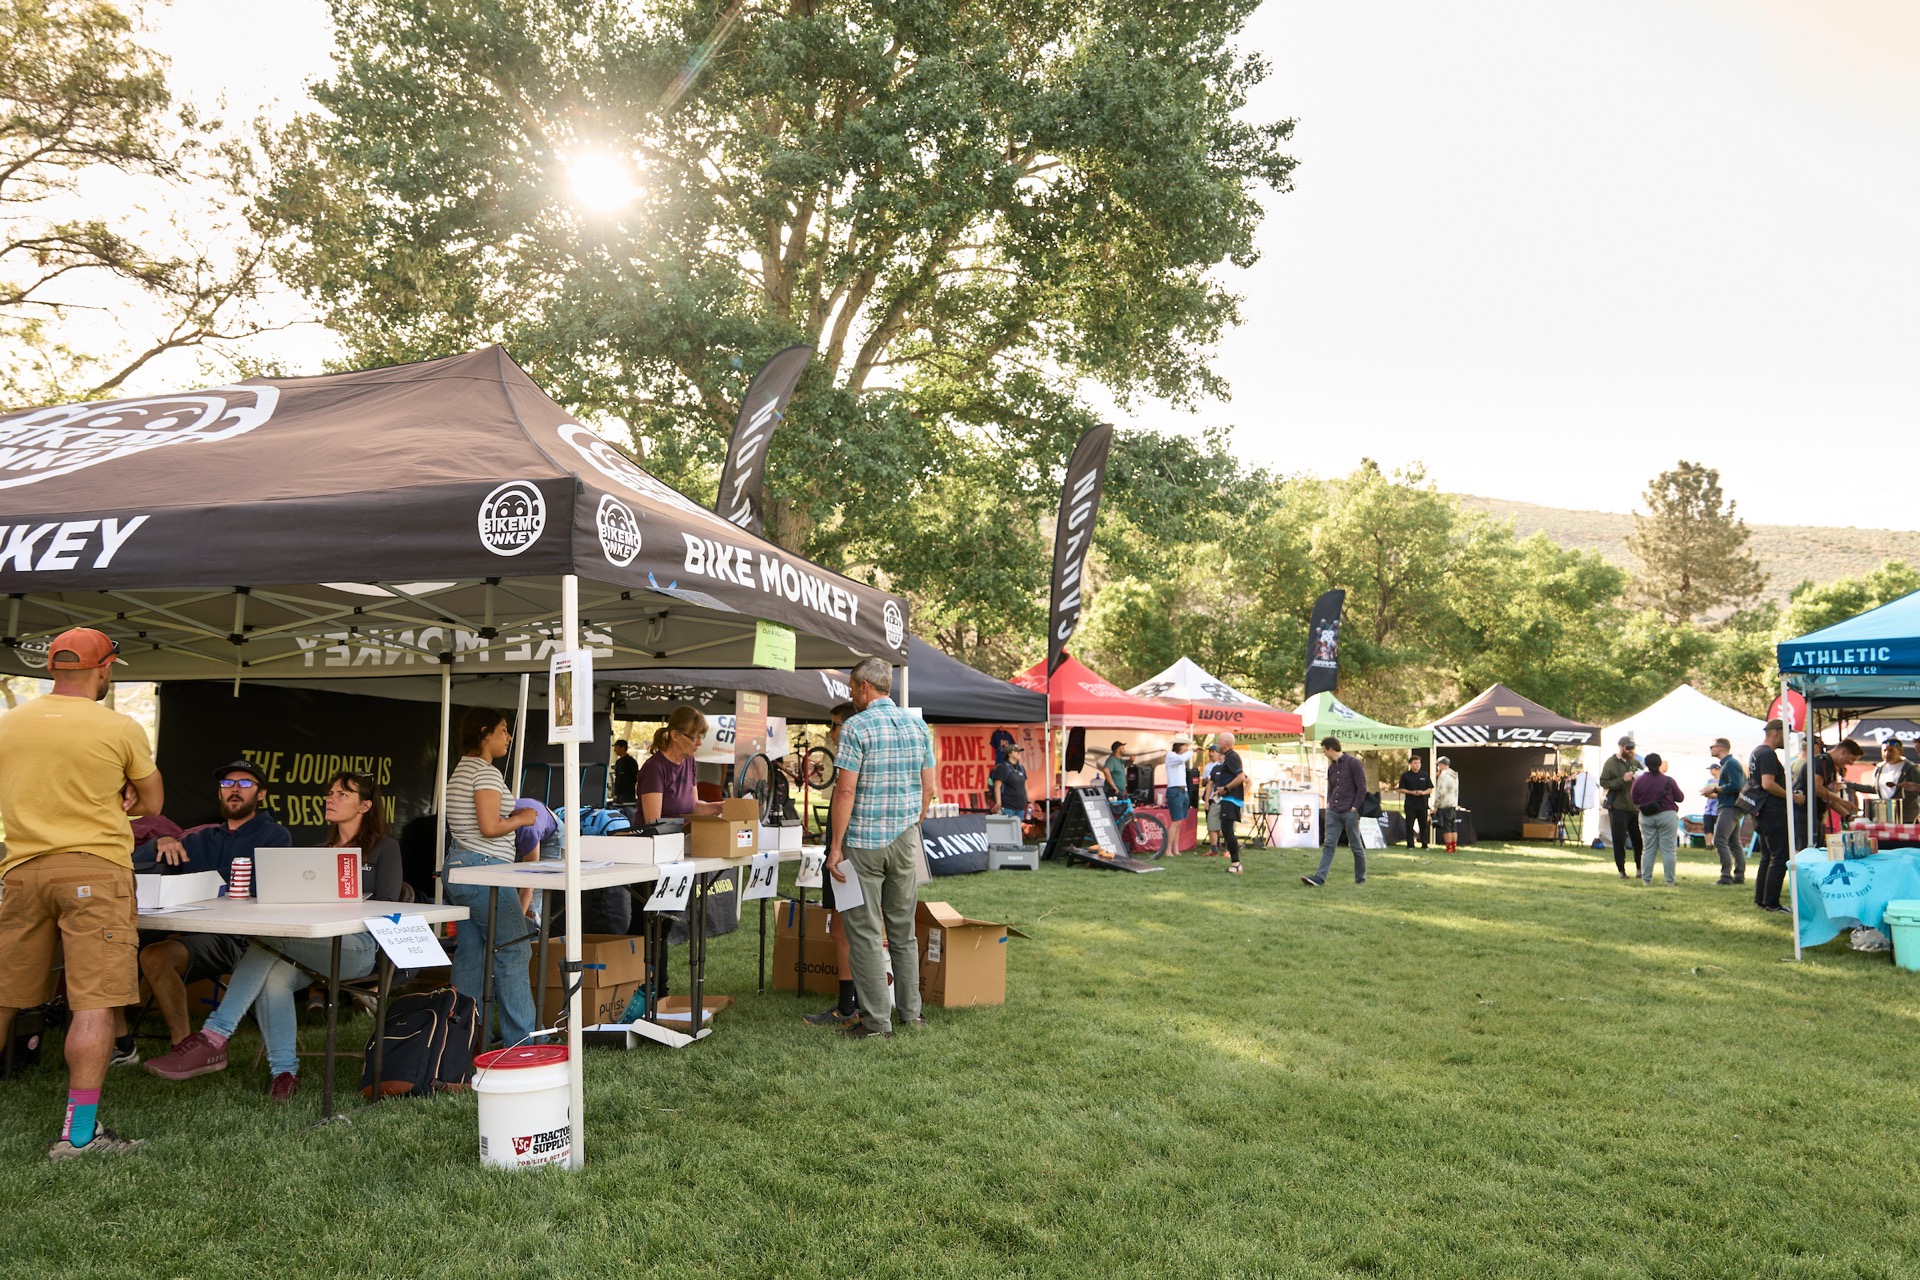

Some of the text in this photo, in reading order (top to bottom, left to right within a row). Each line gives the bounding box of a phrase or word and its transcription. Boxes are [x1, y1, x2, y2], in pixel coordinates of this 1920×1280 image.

[727, 396, 779, 528] NYON
[0, 515, 150, 571] KEY
[1057, 467, 1097, 641] CANYON
[682, 532, 858, 626] BIKE MONKEY
[1791, 647, 1890, 666] ATHLETIC
[1809, 666, 1859, 674] BREWING
[716, 729, 736, 744] CIT
[1330, 729, 1419, 742] RENEWAL by ANDERSEN
[1497, 727, 1592, 743] VOLER
[940, 736, 986, 761] HAVE
[242, 750, 392, 785] THE JOURNEY IS
[376, 925, 427, 936] REG CHANGES
[394, 936, 415, 945] SAME
[408, 946, 423, 954] REG
[794, 962, 838, 975] ascolou
[600, 998, 624, 1017] purist
[513, 1137, 530, 1151] TSC
